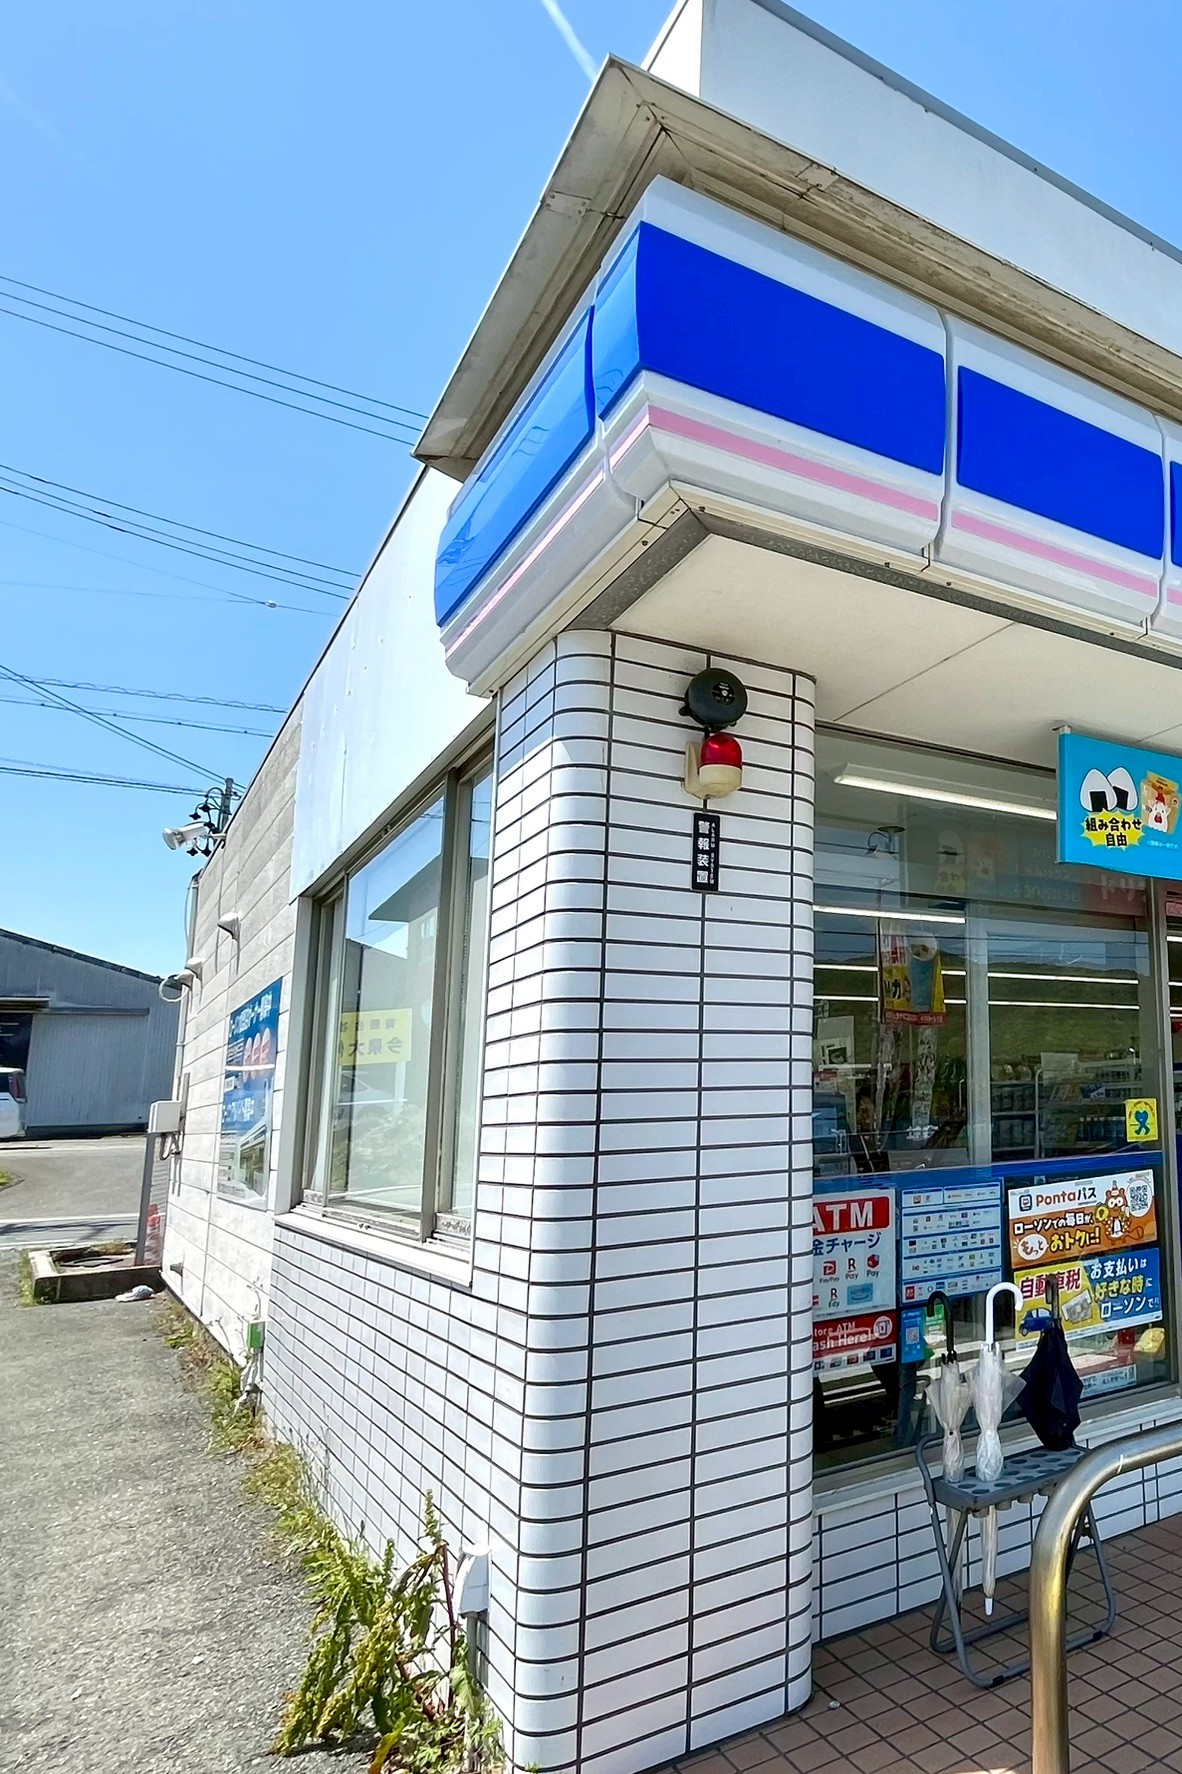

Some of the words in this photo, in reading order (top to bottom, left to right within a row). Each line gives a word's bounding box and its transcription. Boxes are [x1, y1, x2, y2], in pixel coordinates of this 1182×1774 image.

[1085, 816, 1142, 832] 組み合わせ
[697, 820, 710, 883] 警報装置
[1105, 833, 1128, 848] 自由
[1036, 1186, 1098, 1208] Pontaパス
[812, 1201, 873, 1232] ATM
[1050, 1226, 1101, 1253] おトクに!
[1090, 1257, 1148, 1280] お支払いは
[1095, 1274, 1153, 1301] 好きな時に
[813, 1327, 834, 1338] tore
[836, 1320, 856, 1335] ATM
[813, 1336, 835, 1352] ash
